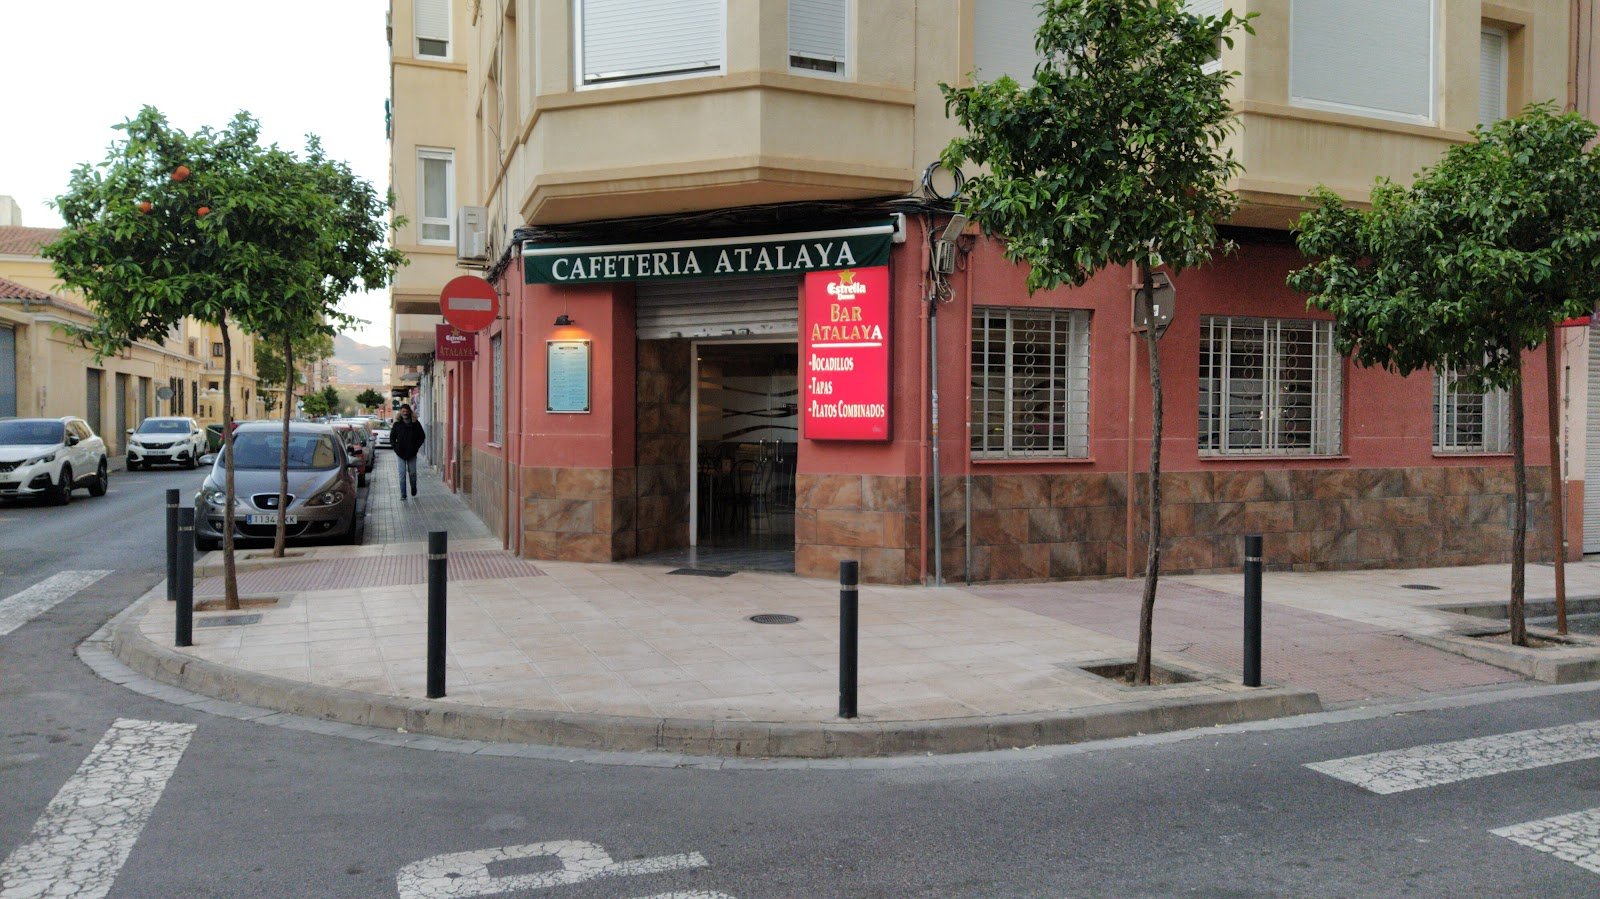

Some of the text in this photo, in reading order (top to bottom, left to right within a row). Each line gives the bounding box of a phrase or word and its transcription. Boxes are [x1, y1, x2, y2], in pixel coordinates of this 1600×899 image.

[551, 240, 857, 281] CAFETERIA ATALAYA
[827, 282, 866, 295] Estrella
[831, 303, 862, 322] BAR
[811, 323, 883, 341] ATALAYA
[811, 376, 833, 395] TAPAS
[812, 400, 884, 418] PLATOS COMBINADOS
